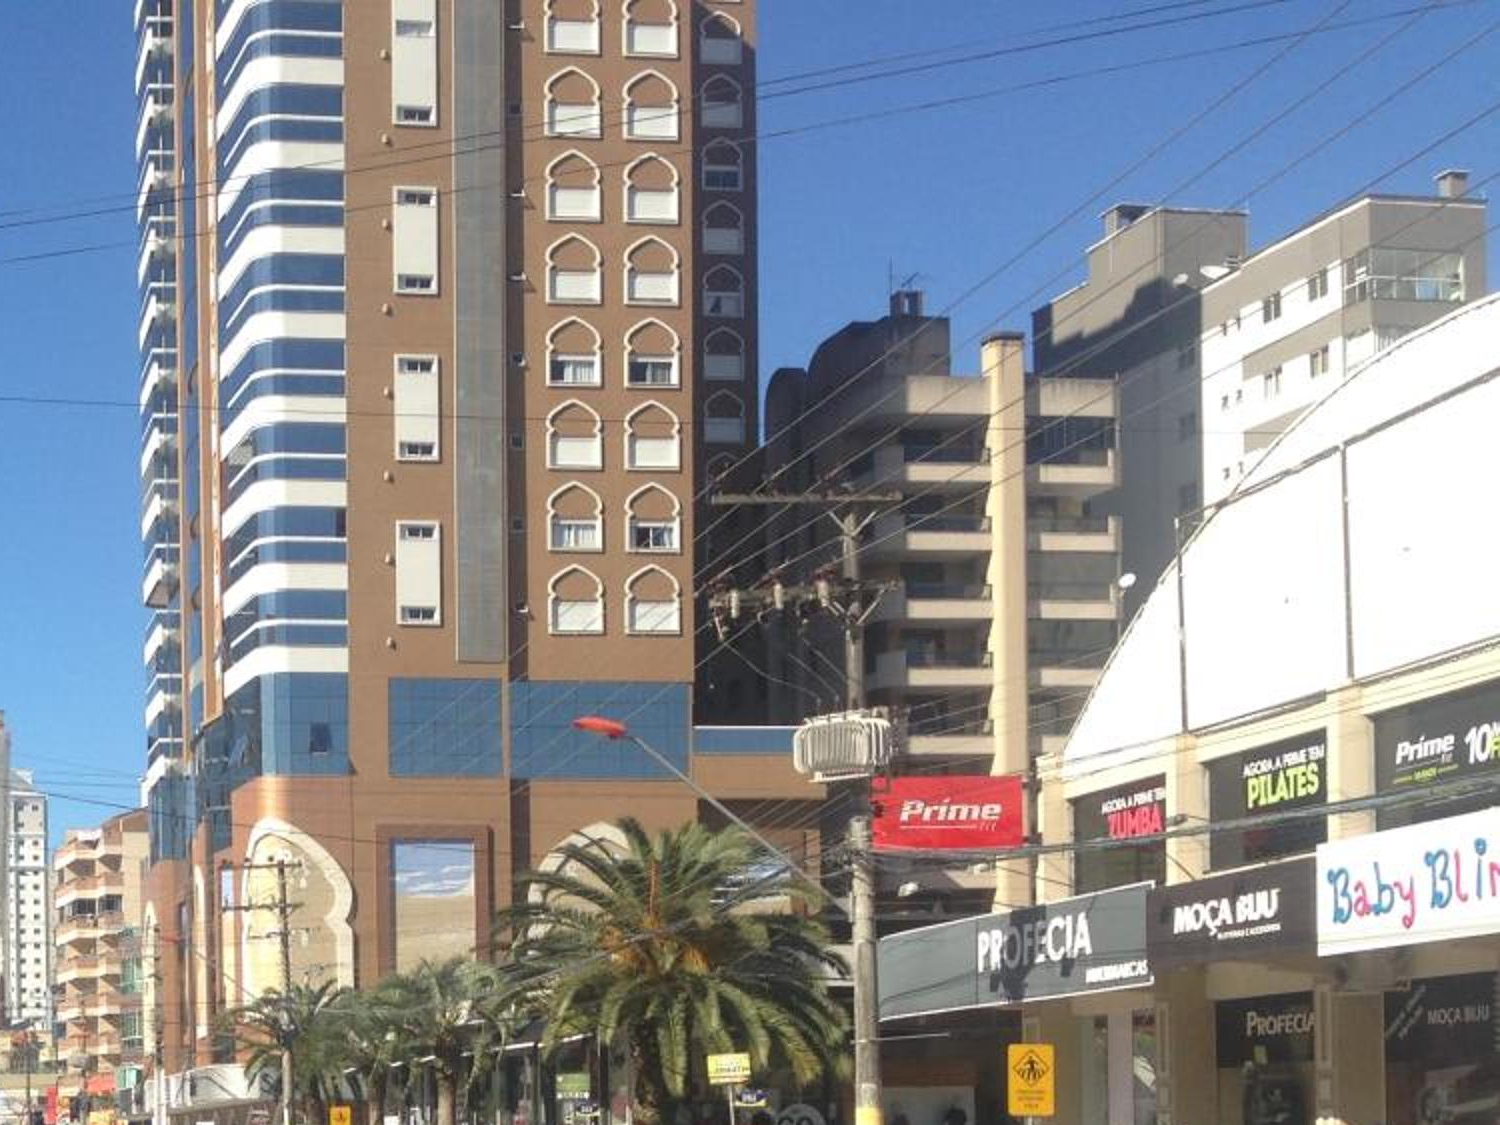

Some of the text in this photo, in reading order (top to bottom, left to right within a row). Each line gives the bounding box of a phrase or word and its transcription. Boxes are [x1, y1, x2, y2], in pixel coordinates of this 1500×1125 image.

[1395, 733, 1455, 765] Prime
[899, 797, 1002, 821] Prime
[1247, 762, 1320, 809] PILATES
[1108, 803, 1162, 840] ZUMBA
[1173, 888, 1281, 937] MOÇA BIJU
[1327, 861, 1416, 929] Baby
[977, 911, 1093, 973] PROFECIA
